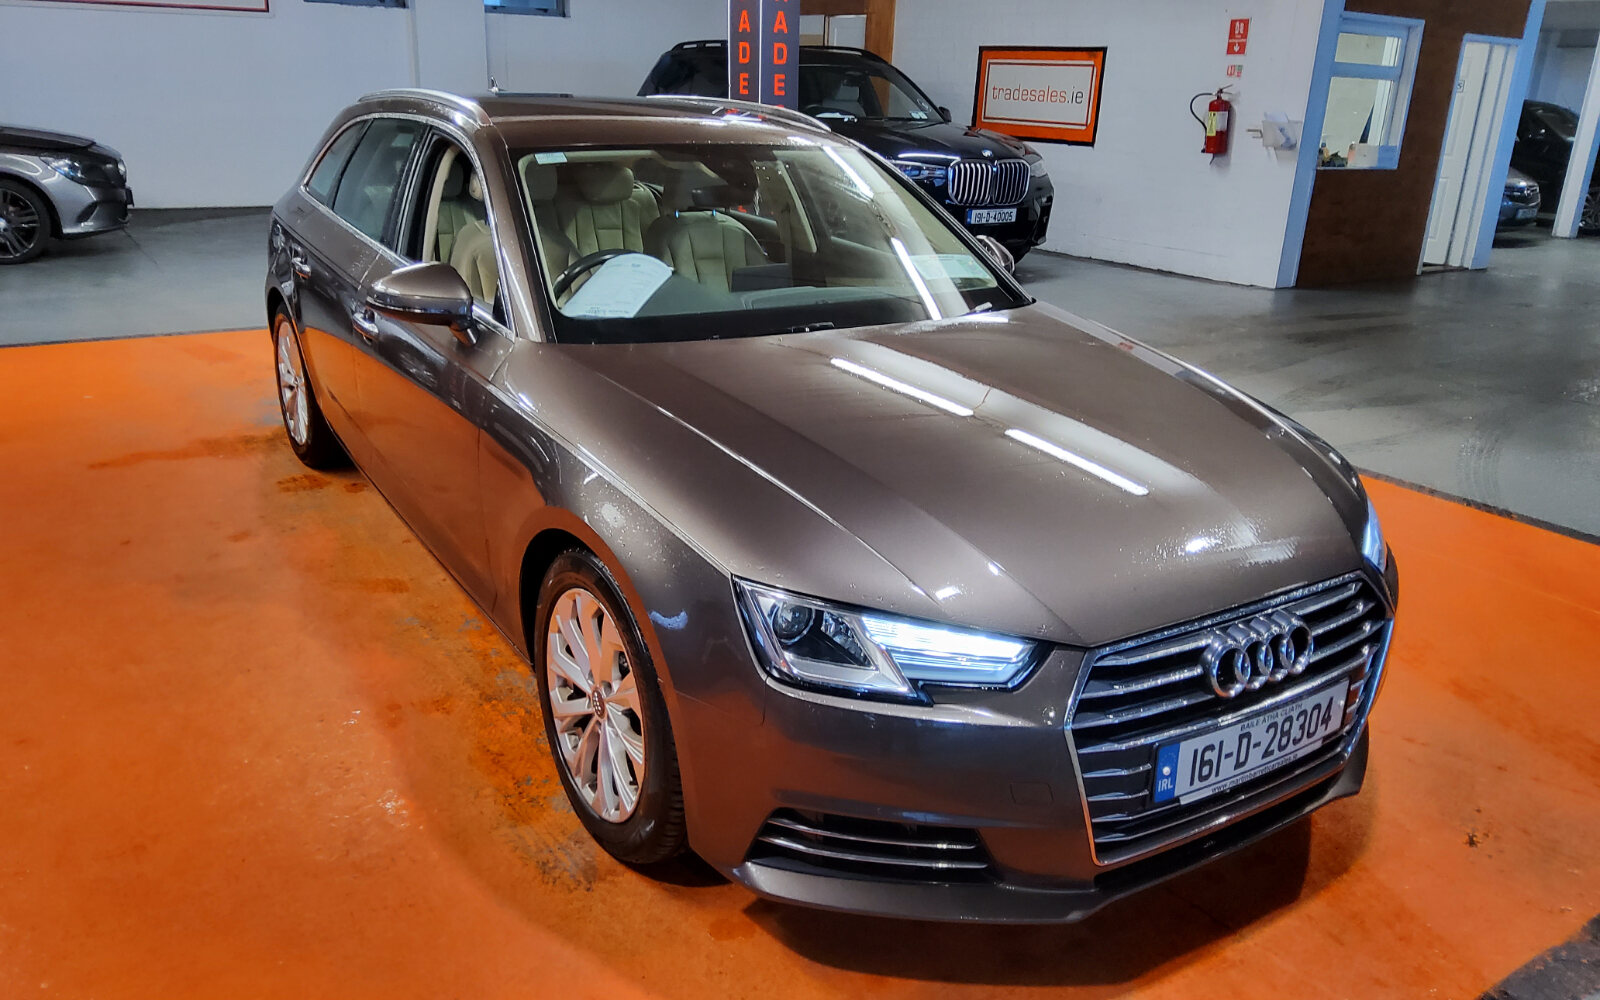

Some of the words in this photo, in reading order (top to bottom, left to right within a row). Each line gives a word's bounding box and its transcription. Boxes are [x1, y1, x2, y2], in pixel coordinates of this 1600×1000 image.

[738, 0, 751, 95] ADE
[773, 0, 789, 108] ADE
[992, 83, 1084, 105] tradesales.ie
[1157, 777, 1174, 793] IRL
[1189, 696, 1334, 787] 161-D-28304
